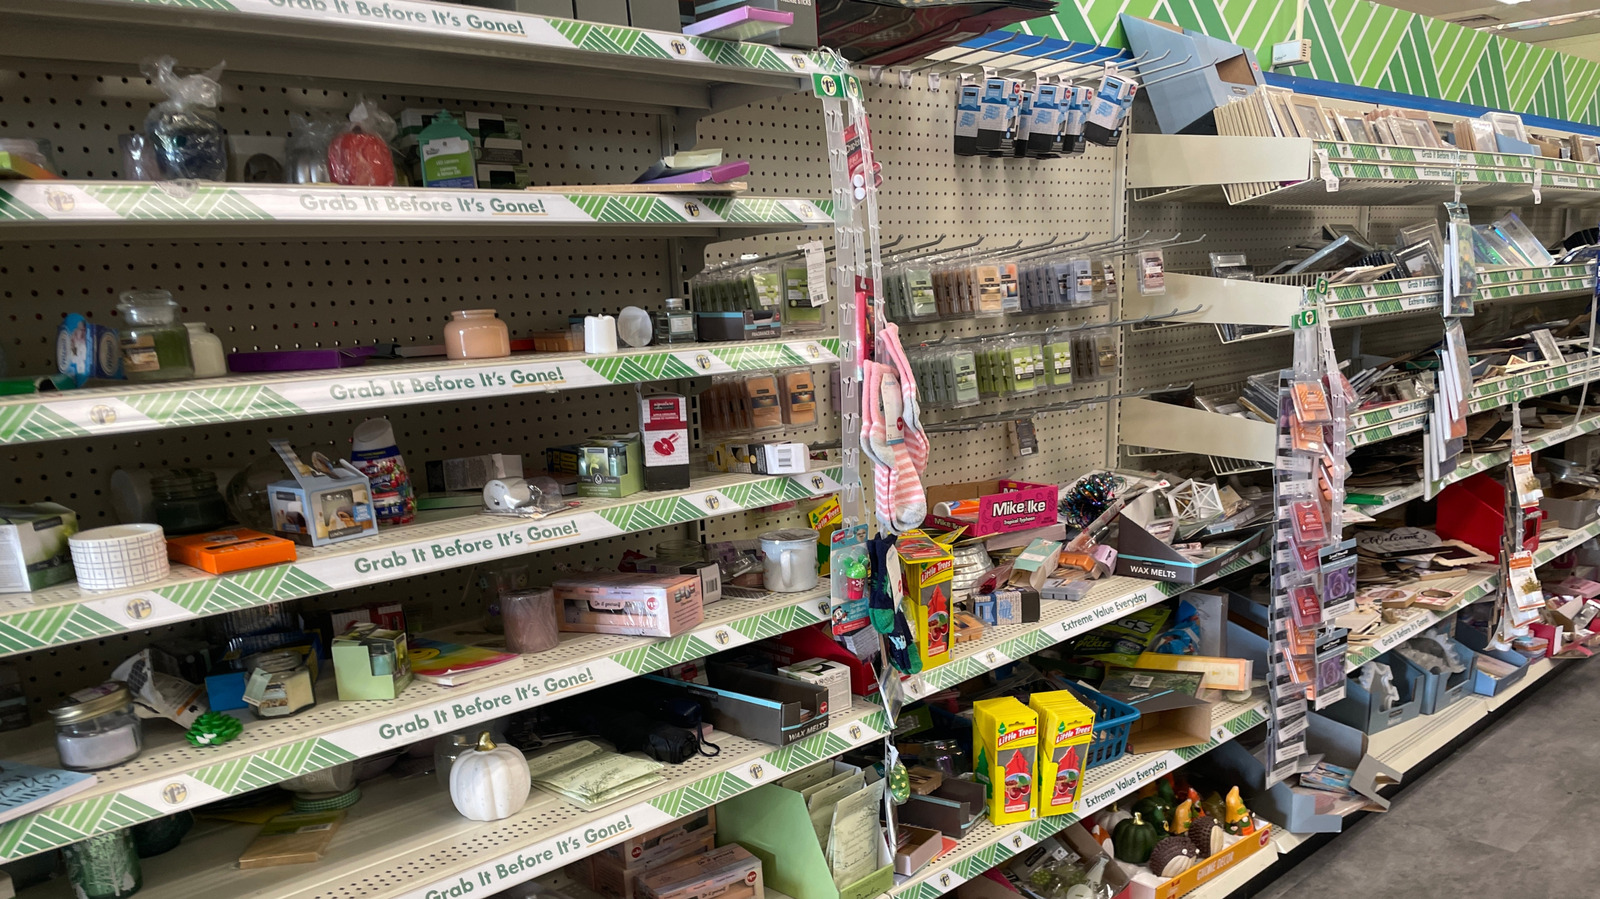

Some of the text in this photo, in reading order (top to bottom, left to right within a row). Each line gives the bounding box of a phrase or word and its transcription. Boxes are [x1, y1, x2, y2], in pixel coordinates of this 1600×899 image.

[357, 0, 427, 23] Before
[432, 9, 461, 27] It's
[466, 14, 526, 34] Gone!
[300, 194, 546, 214] Grab It Before It's Gone!
[329, 366, 565, 400] Grab It Before It's Gone!
[992, 500, 1046, 517] Mike Ike
[934, 517, 951, 528] Mike
[1003, 518, 1019, 526] Tropical
[1019, 516, 1036, 525] Typhoon
[354, 520, 579, 573] Grab It Before It's Gone!
[1361, 530, 1427, 547] Welcome
[921, 559, 951, 583] Little Trees
[1130, 565, 1177, 579] WAX MELTS
[1061, 593, 1148, 631] Extreme Value Everyday
[1398, 628, 1411, 639] Before
[379, 667, 594, 739] Grab It Before It's Gone!
[1033, 716, 1037, 725] 1
[1090, 715, 1094, 724] 1
[788, 720, 827, 742] WAX MELTS
[998, 727, 1036, 746] Little Trees
[1056, 725, 1092, 745] Little Trees
[1085, 760, 1168, 808] Extreme Value Everyday
[425, 815, 632, 899] Grab It Before It's Gone!
[1196, 851, 1235, 881] GNOME DECOR
